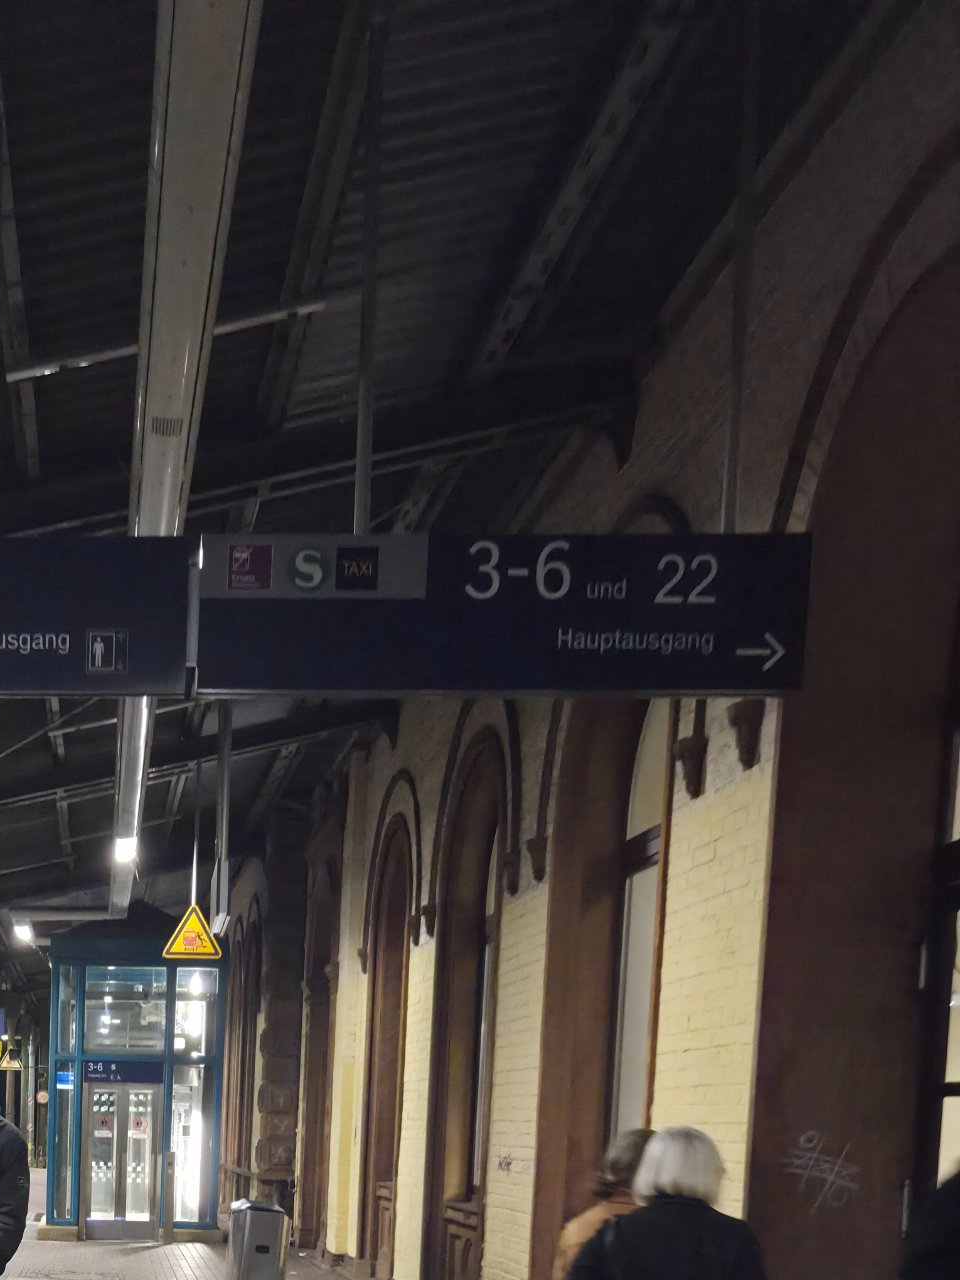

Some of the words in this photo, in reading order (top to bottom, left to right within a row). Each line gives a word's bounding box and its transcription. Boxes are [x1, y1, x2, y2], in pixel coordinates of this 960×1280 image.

[294, 549, 323, 588] S
[342, 560, 373, 577] TAXI
[586, 579, 628, 600] und
[654, 553, 720, 605] 22
[557, 627, 715, 655] Hauptausgang
